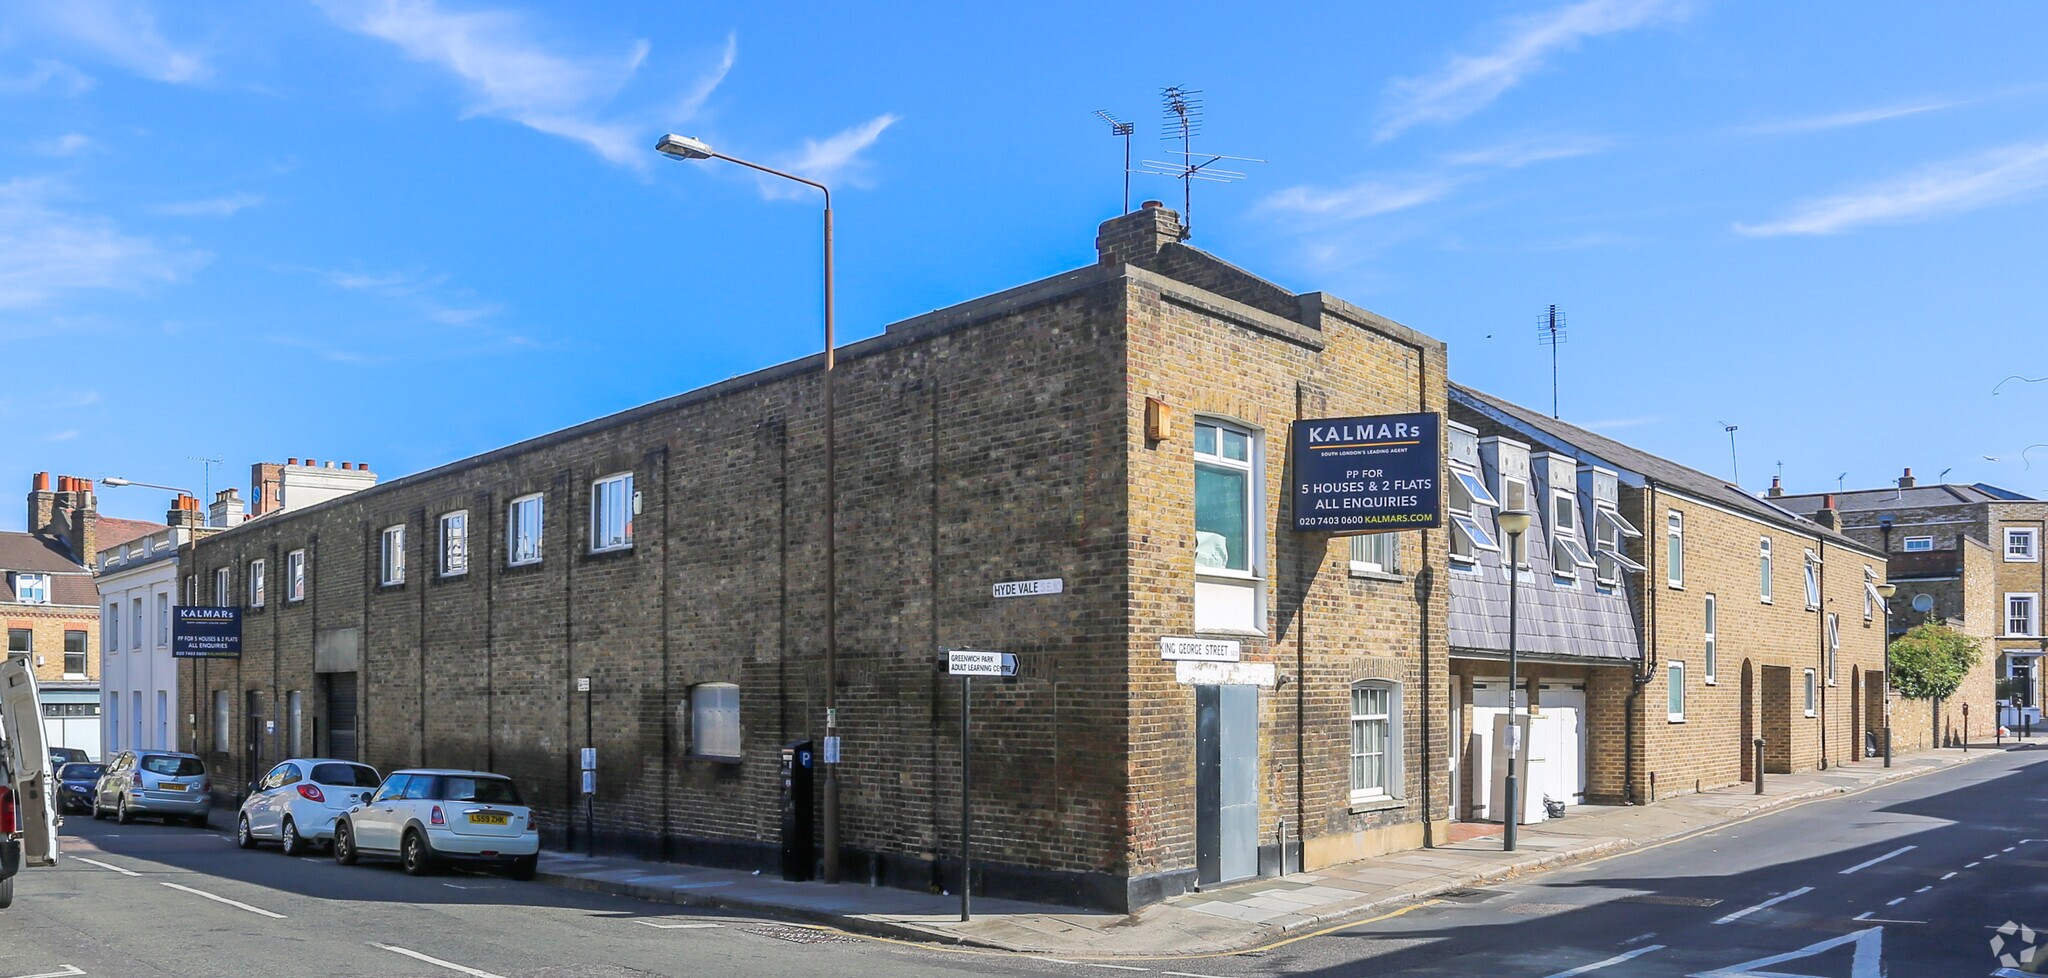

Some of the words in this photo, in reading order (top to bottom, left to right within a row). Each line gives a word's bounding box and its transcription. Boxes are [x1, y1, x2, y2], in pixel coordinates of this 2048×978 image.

[1309, 423, 1420, 443] KALMARs
[1346, 470, 1359, 478] PP
[1362, 469, 1383, 478] FOR
[1302, 484, 1309, 494] 5
[1313, 482, 1364, 493] HOUSES
[1368, 481, 1378, 491] &
[1382, 480, 1390, 491] 2
[1394, 479, 1432, 490] FLATS
[1315, 499, 1339, 509] ALL
[1343, 496, 1417, 509] ENQUIRIES
[1300, 517, 1316, 525] 020
[1317, 516, 1339, 525] 7403
[1341, 516, 1363, 524] 0600
[1364, 514, 1433, 524] KALMARS.COM
[994, 584, 1016, 595] HYDE
[1018, 582, 1038, 594] VALE
[181, 609, 234, 618] KALMARs
[1160, 642, 1176, 654] KING
[1179, 643, 1202, 655] GEORGE
[1205, 644, 1228, 656] STREET
[951, 654, 980, 662] GREENWICH
[951, 663, 967, 671] ADULT
[968, 664, 992, 672] LEARNING
[803, 752, 810, 766] P
